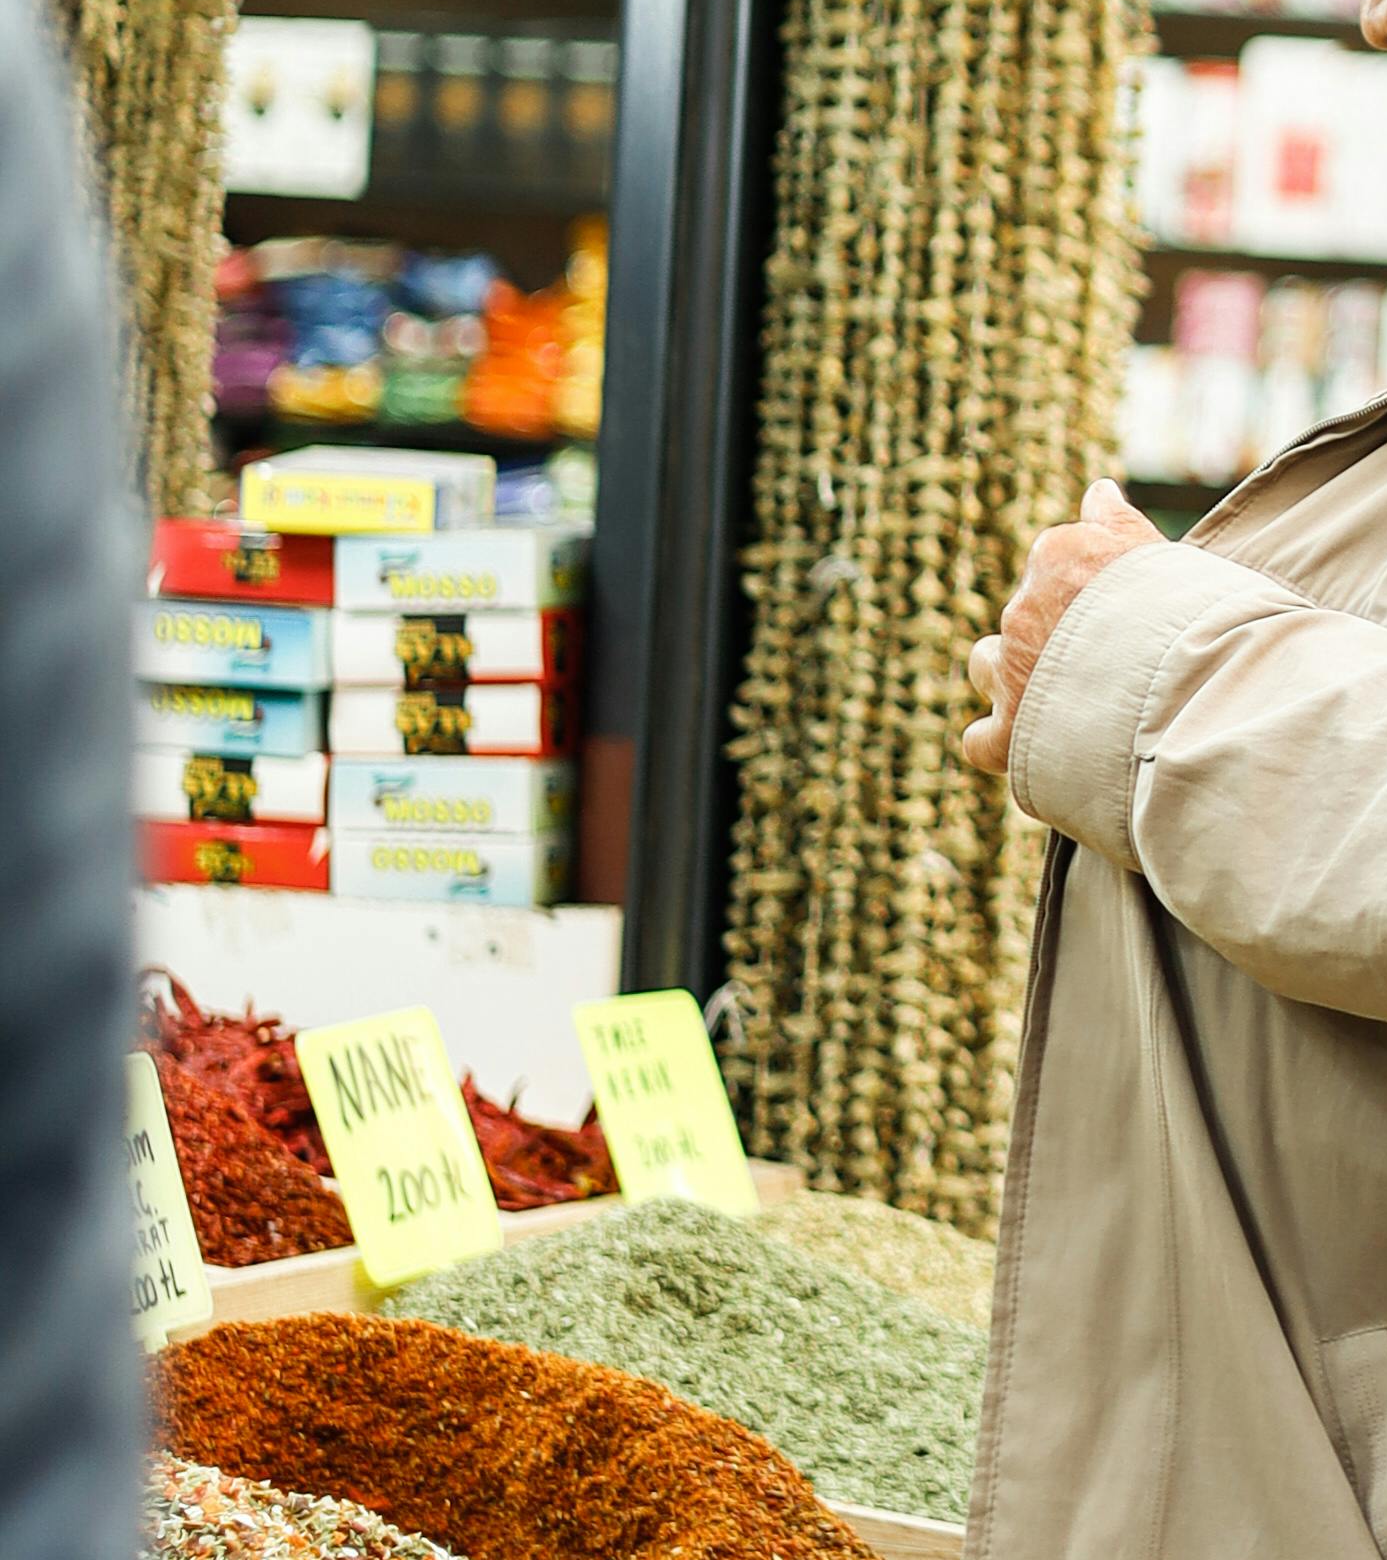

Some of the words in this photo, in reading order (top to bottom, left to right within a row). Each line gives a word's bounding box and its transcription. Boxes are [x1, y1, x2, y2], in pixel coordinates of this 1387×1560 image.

[388, 570, 498, 601] MOSSO
[154, 612, 263, 650] MOSSO
[383, 797, 492, 826] MOSSO
[372, 845, 479, 875] MOSSO
[327, 1033, 431, 1132] NANE
[378, 1164, 440, 1223] 200
